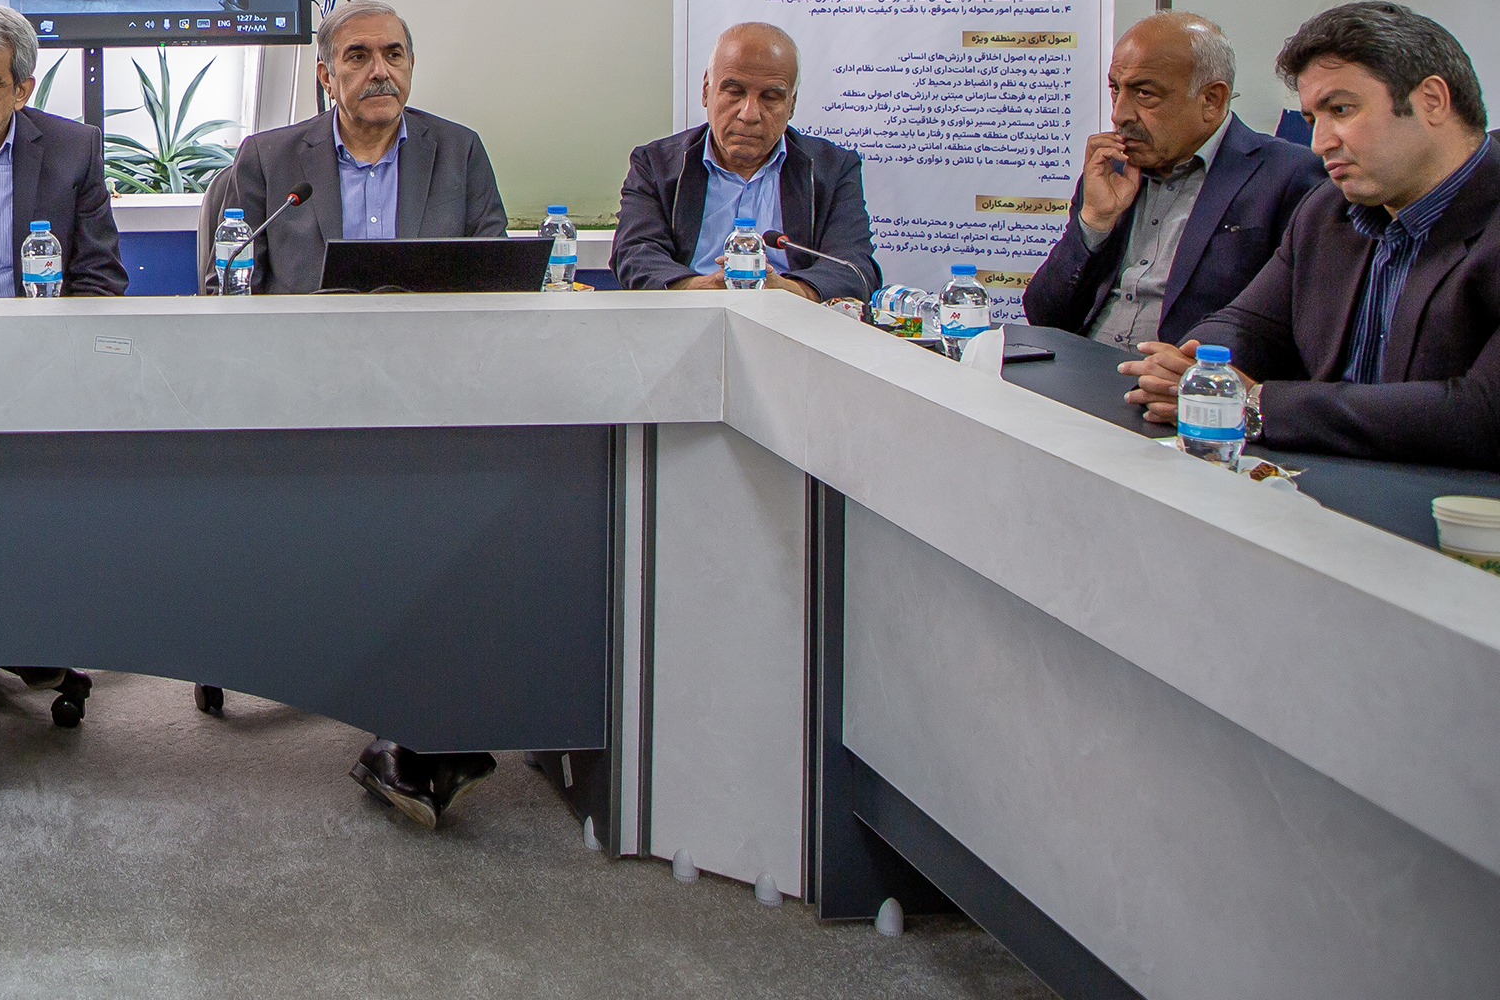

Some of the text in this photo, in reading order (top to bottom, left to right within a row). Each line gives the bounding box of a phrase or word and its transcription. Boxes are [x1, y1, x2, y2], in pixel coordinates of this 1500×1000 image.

[833, 6, 853, 16] انجام
[855, 6, 866, 15] بالا
[868, 5, 893, 15] کیفیت
[894, 8, 899, 16] و
[900, 4, 919, 13] دقت
[920, 6, 926, 15] با
[961, 5, 967, 16] را
[968, 5, 994, 16] محوله
[995, 6, 1012, 16] امور
[1014, 7, 1050, 17] متعهدیم
[972, 35, 988, 44] ویژه
[1017, 36, 1026, 44] در
[1028, 35, 1047, 44] کاری
[1048, 35, 1071, 45] اصول
[974, 52, 1002, 63] اخلاقی
[1003, 53, 1026, 64] اصول
[1028, 56, 1037, 64] به
[1038, 54, 1064, 65] احترام
[928, 78, 952, 88] محیط
[952, 80, 962, 89] در
[964, 78, 992, 89] انضباط
[993, 82, 999, 90] و
[1000, 79, 1017, 90] نظم
[1018, 81, 1027, 90] به
[1029, 78, 1060, 91] پایبندی
[898, 118, 907, 126] در
[908, 116, 939, 126] خلاقیت
[947, 116, 974, 128] نوآوری
[997, 120, 1007, 129] در
[1007, 120, 1035, 129] مستمر
[1036, 120, 1060, 130] تلاش
[981, 200, 1068, 212] اصول در برابر همکاران
